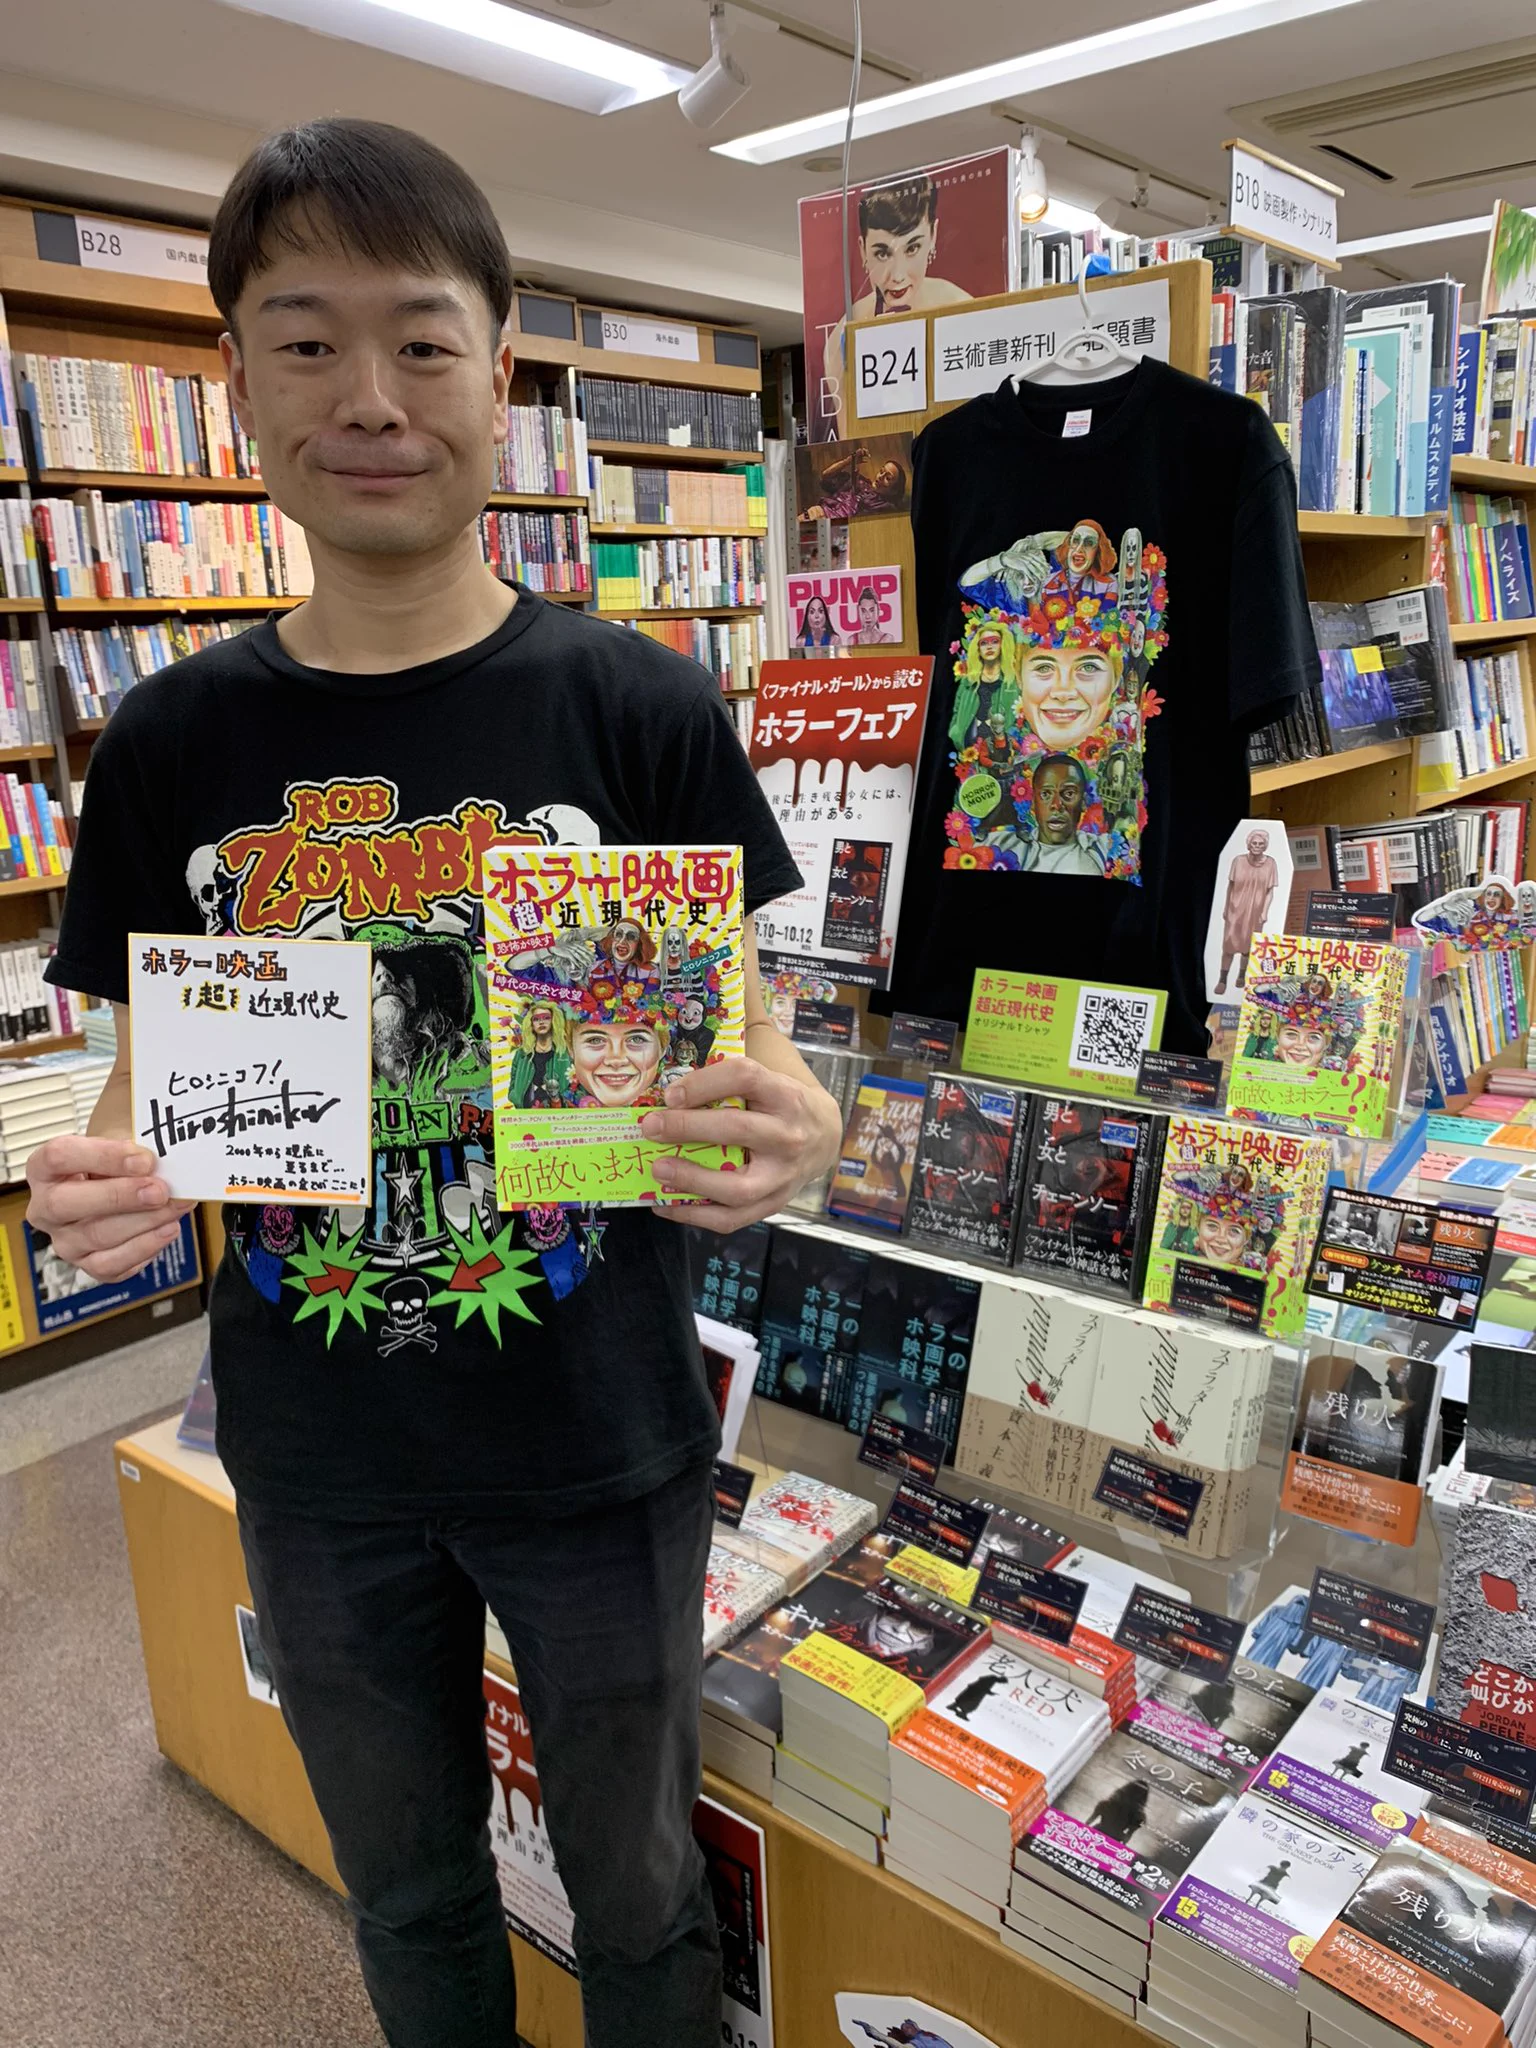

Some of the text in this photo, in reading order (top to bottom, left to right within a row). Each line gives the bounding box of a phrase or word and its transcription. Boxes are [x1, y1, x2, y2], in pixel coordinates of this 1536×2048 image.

[1236, 172, 1260, 211] B18
[1263, 190, 1332, 238] 映画製作・シナリオ
[81, 230, 122, 257] B28
[603, 322, 628, 341] B30
[942, 331, 1056, 371] 芸術書新刊
[861, 347, 919, 388] B24
[1452, 346, 1470, 442] シナリオ技法
[1499, 538, 1521, 604] ノベライズ
[788, 574, 898, 608] PUMP
[755, 702, 918, 748] ホラーフェア
[962, 779, 997, 801] HORROR
[966, 790, 996, 808] MOVIE
[290, 783, 391, 831] ROB
[218, 804, 545, 932] ZOMBI
[487, 850, 735, 916] ホラー映画
[496, 934, 553, 955] 恐怖が映す
[1251, 935, 1384, 974] ホラー映画
[141, 947, 288, 982] ホラー映画
[494, 976, 583, 1001] 時代の不安と欲望
[979, 975, 1059, 1002] ホラー映画
[975, 996, 1054, 1024] 超近現代史
[930, 1080, 958, 1102] 男と
[1042, 1100, 1074, 1125] 男と
[924, 1119, 952, 1141] 女と
[1102, 1124, 1137, 1142] サイン本
[1036, 1142, 1068, 1166] 女と
[1169, 1120, 1304, 1173] ホラー映画
[918, 1157, 999, 1186] チェーンソー
[1031, 1183, 1119, 1213] チェーンソー
[804, 1285, 862, 1310] ホラー
[801, 1304, 859, 1335] 映画の
[905, 1316, 970, 1344] ホラー
[798, 1326, 836, 1351] 科学
[901, 1337, 967, 1371] 映画の
[899, 1358, 941, 1386] 科学
[1323, 1390, 1396, 1431] 残り火
[984, 1650, 1083, 1713] 老人と犬
[1474, 1663, 1534, 1694] どこか
[1008, 1686, 1056, 1718] RED
[1470, 1683, 1535, 1715] 叫びが
[1479, 1719, 1525, 1743] PEELE
[1480, 1710, 1527, 1731] JORDAN
[1237, 1805, 1369, 1879] 隣の家の少女
[1132, 1860, 1172, 1890] 第2位
